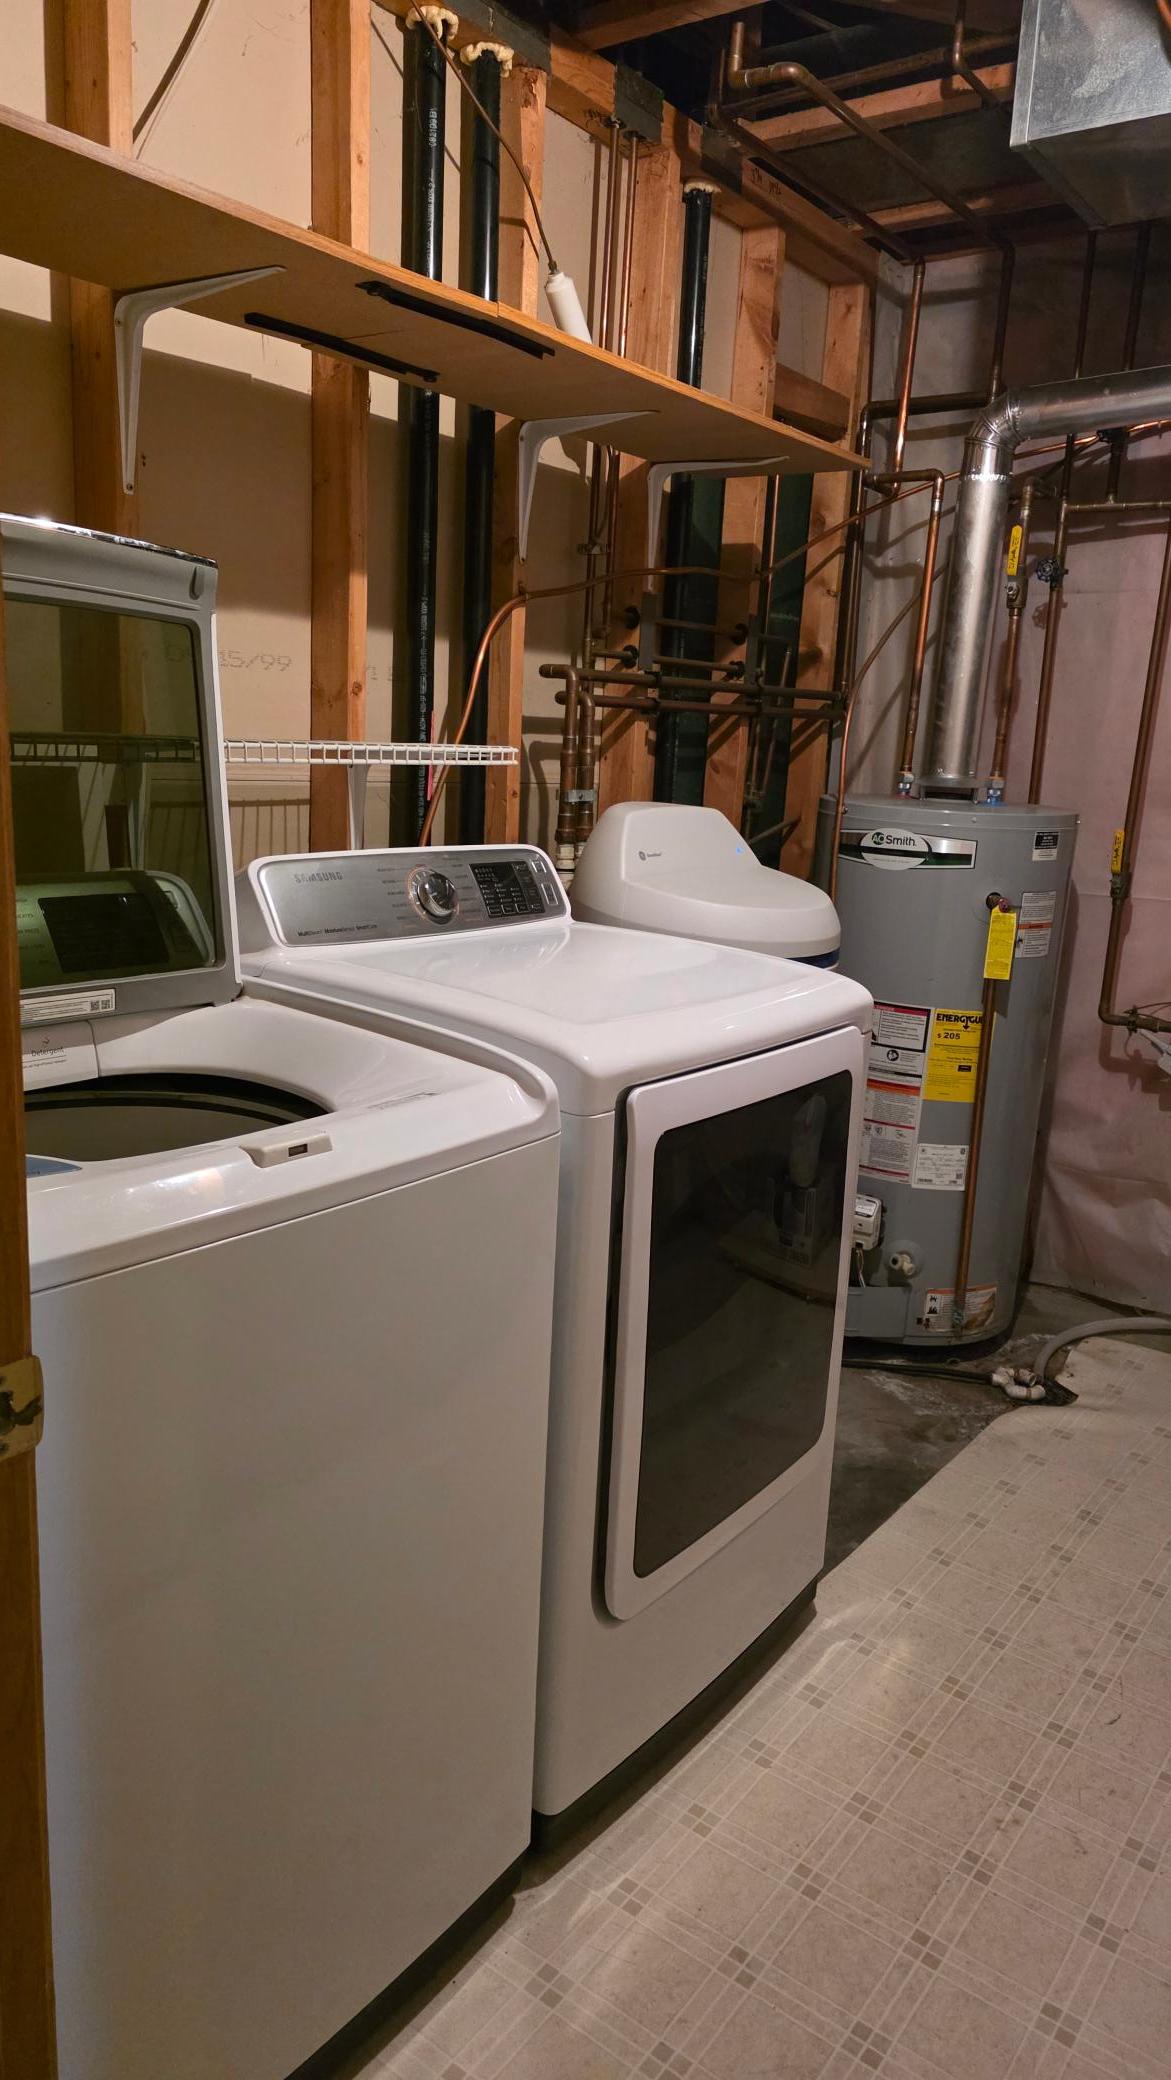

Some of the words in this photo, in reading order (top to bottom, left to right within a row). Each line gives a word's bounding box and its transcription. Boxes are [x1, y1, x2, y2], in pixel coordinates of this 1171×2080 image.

[885, 834, 916, 847] Smith
[294, 871, 344, 884] SAMSUNG
[31, 1046, 64, 1057] Detergent
